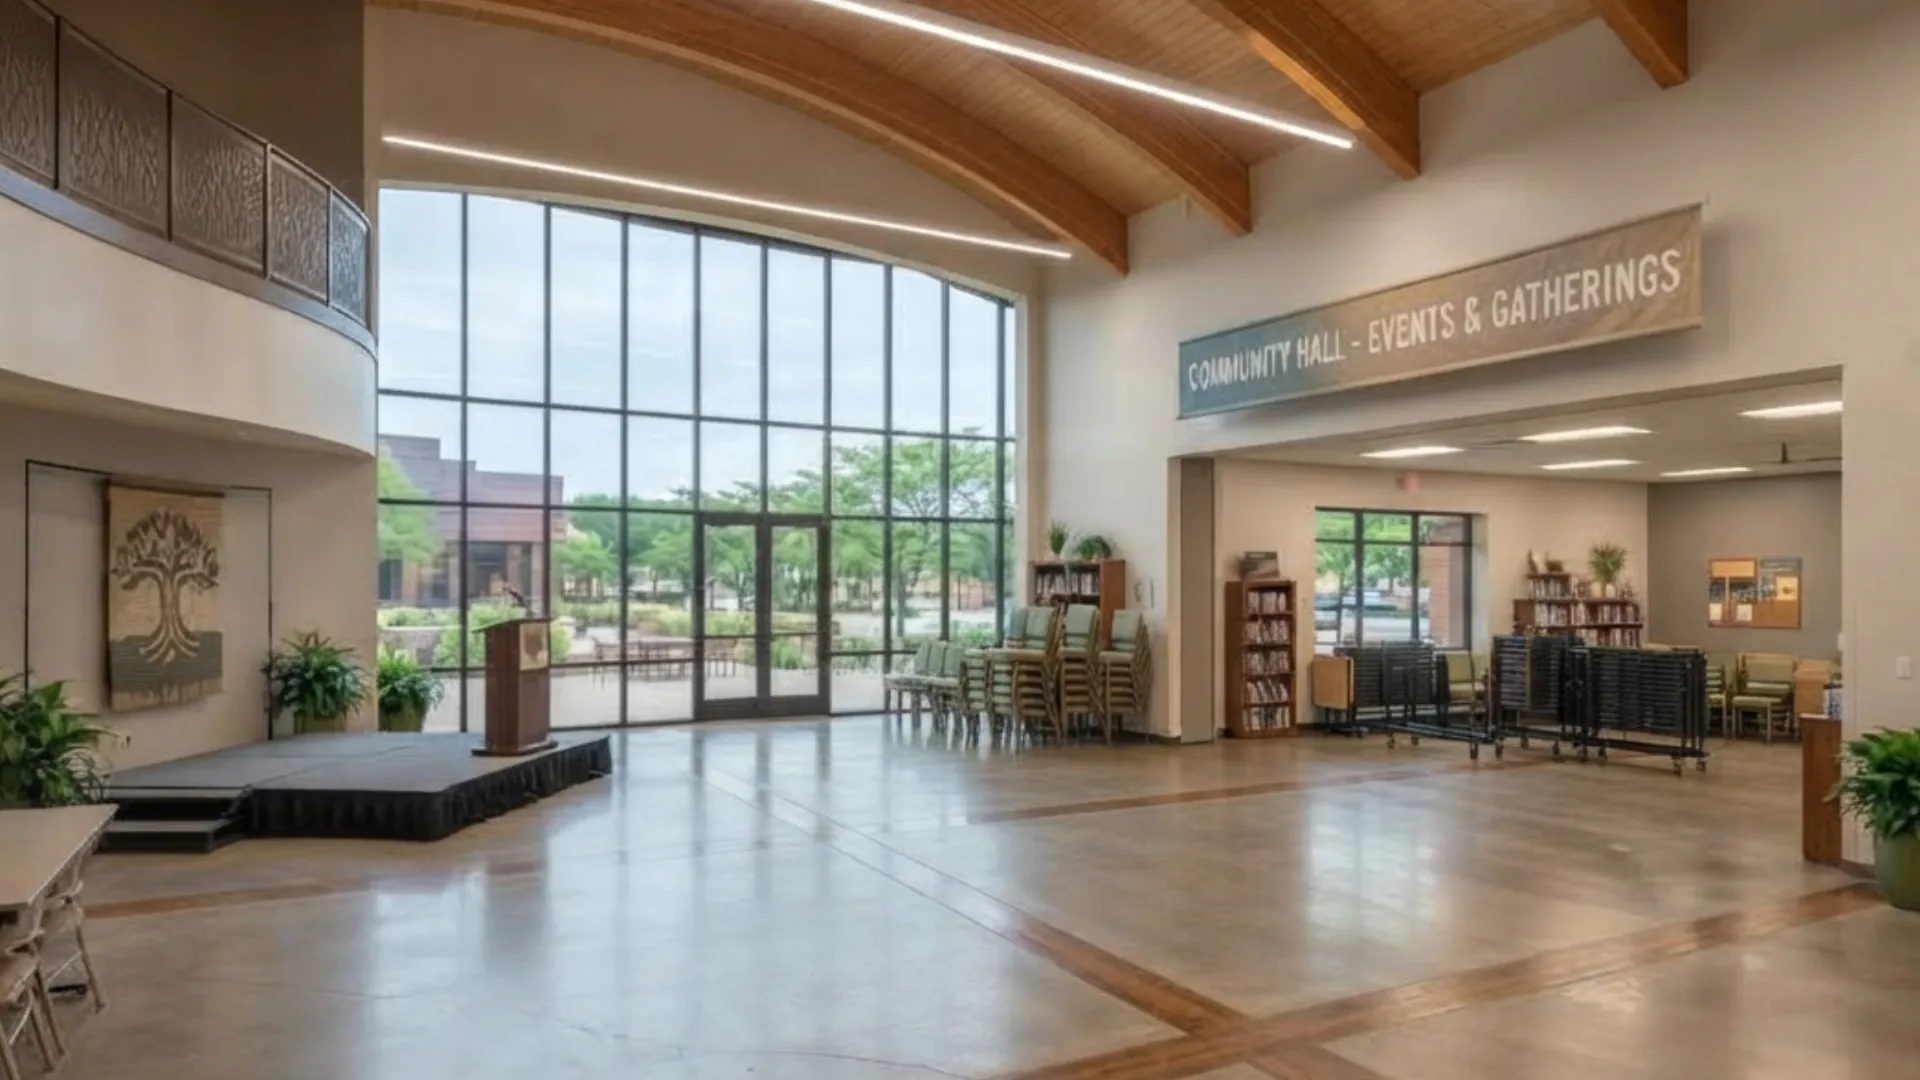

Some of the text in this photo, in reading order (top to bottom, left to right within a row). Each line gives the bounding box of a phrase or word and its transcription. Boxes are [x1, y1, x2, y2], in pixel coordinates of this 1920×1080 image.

[1188, 249, 1681, 391] COMMUNITY HALL - EVENTS & GATHERINGS
